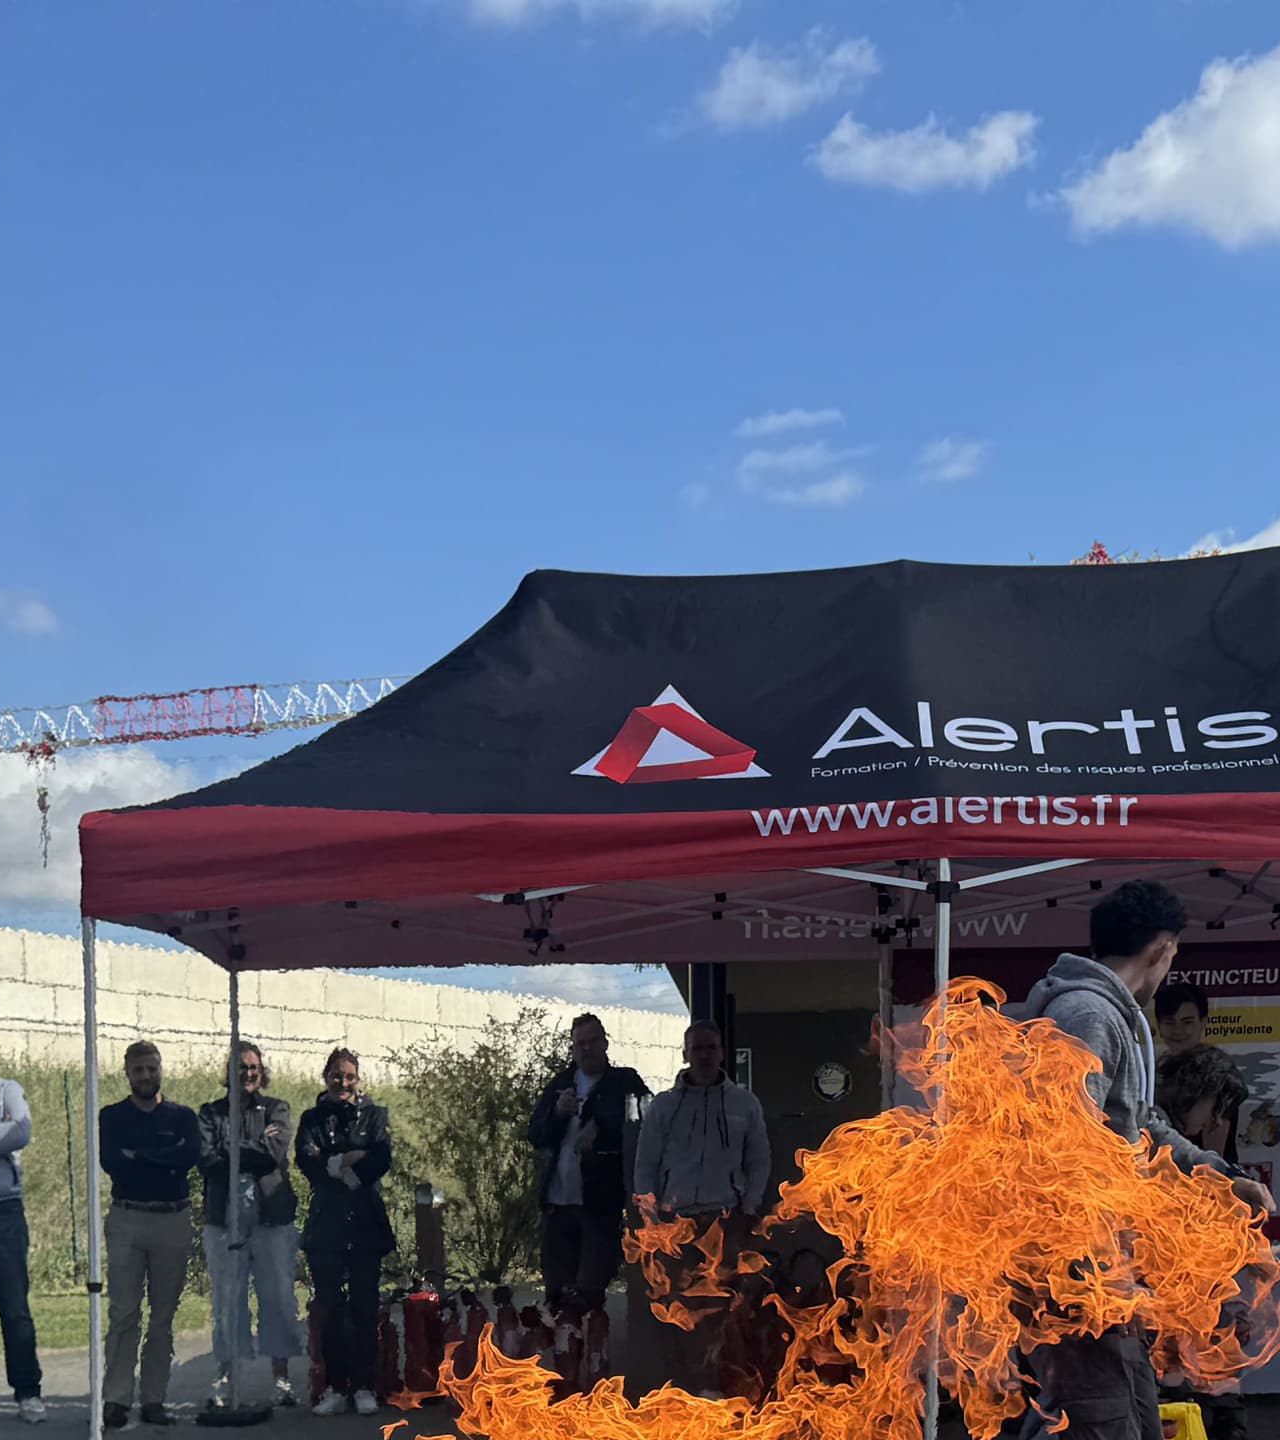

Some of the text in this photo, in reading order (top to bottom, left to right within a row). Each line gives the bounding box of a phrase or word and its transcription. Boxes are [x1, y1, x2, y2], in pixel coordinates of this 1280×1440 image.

[812, 702, 1278, 758] Alertis
[811, 759, 907, 778] Formation
[928, 756, 1029, 773] Prévention
[1036, 762, 1071, 774] des
[1077, 764, 1146, 775] risques
[751, 794, 1139, 837] www.alertis.fr
[1207, 1015, 1242, 1024] cteur
[1205, 1024, 1273, 1038] polyvalente
